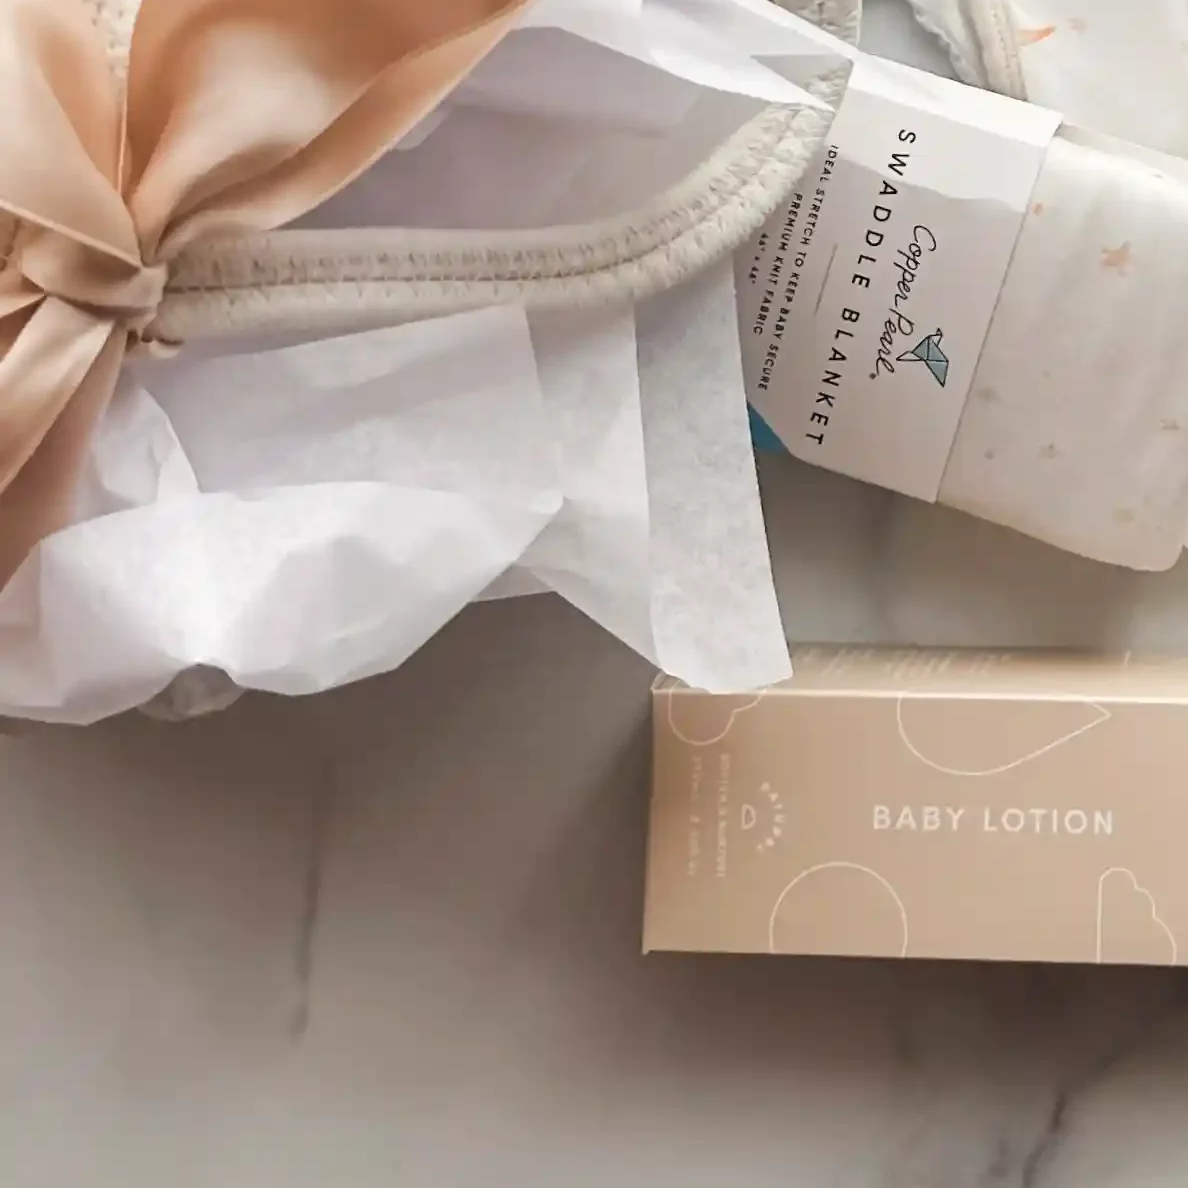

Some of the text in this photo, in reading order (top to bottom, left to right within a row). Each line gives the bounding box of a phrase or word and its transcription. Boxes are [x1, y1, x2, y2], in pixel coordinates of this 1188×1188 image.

[754, 192, 803, 335] PREMIUM KNIT FABRIC
[757, 144, 839, 390] IDEAL STRETCH TO KEEP BABY SECURE
[806, 129, 916, 444] SWADDLE BLANKET
[893, 225, 937, 307] Copper
[873, 804, 1113, 835] BABY LOTION
